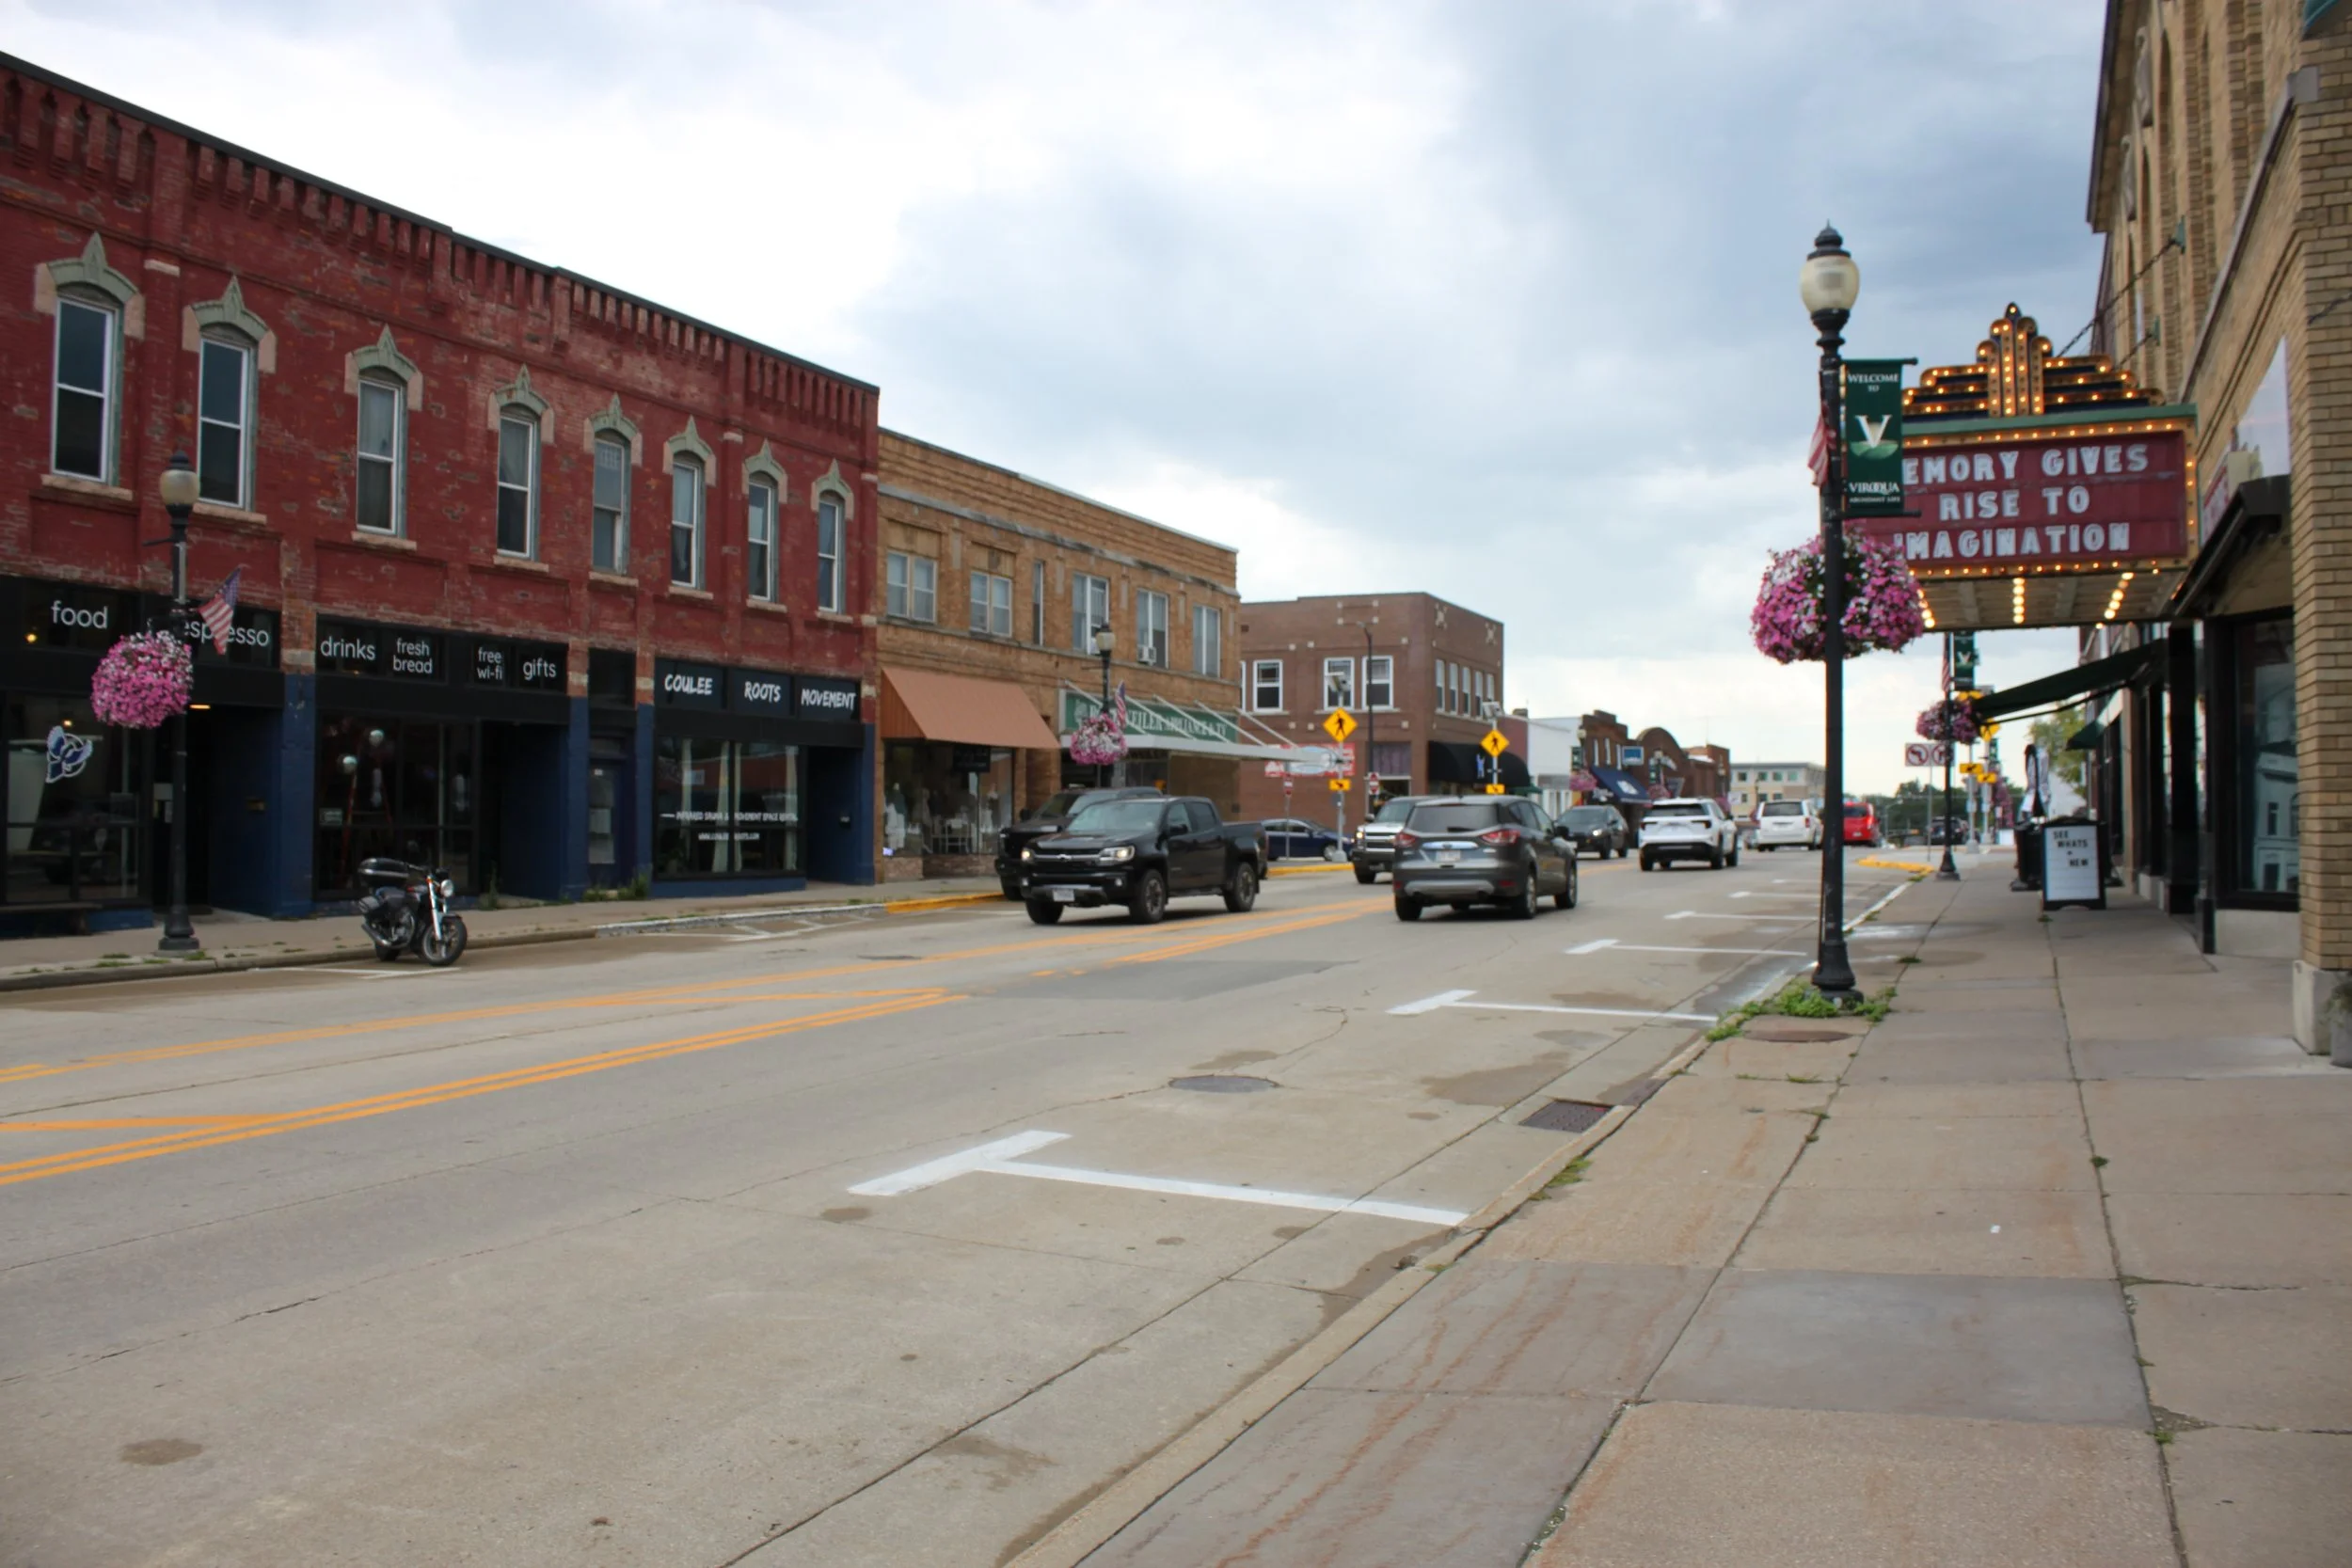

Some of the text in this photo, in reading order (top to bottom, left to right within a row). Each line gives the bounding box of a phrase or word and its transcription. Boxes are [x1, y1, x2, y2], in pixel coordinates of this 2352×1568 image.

[1847, 372, 1899, 384] WELCOME
[1867, 384, 1880, 392] TO
[1902, 444, 2149, 485] EMORY GIVES
[1849, 481, 1900, 496] VIROQUA
[1939, 485, 2090, 520] RISE TO
[1893, 522, 2131, 561] IMAGINATION
[51, 600, 108, 629] food
[184, 620, 270, 647] spesso
[320, 636, 375, 660] drinks
[396, 637, 430, 657] fresh
[478, 647, 502, 664] free
[392, 656, 434, 674] bread
[477, 664, 503, 681] wi-fi
[522, 657, 557, 680] gifts
[664, 673, 857, 711] COULEE ROOTS MOVEMENT
[2054, 830, 2068, 840] SEE
[2070, 858, 2089, 867] NEW
